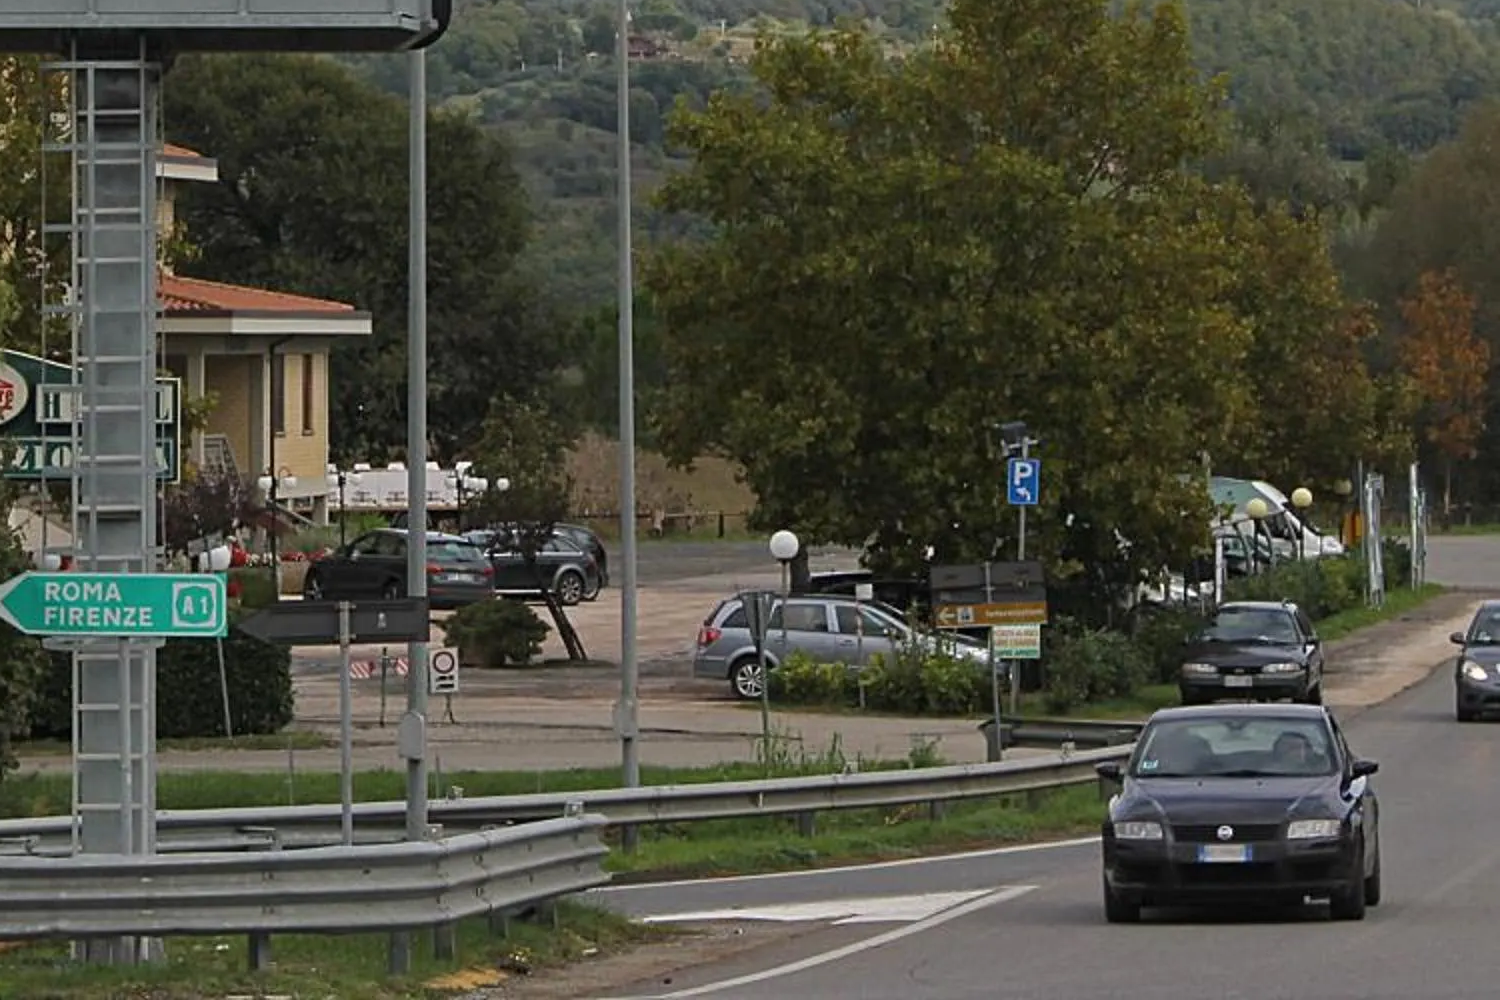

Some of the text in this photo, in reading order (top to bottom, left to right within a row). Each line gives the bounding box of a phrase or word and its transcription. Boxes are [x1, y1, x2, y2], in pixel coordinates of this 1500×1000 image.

[1013, 460, 1034, 487] P
[43, 581, 123, 602] ROMA
[43, 606, 154, 628] FIRENZE
